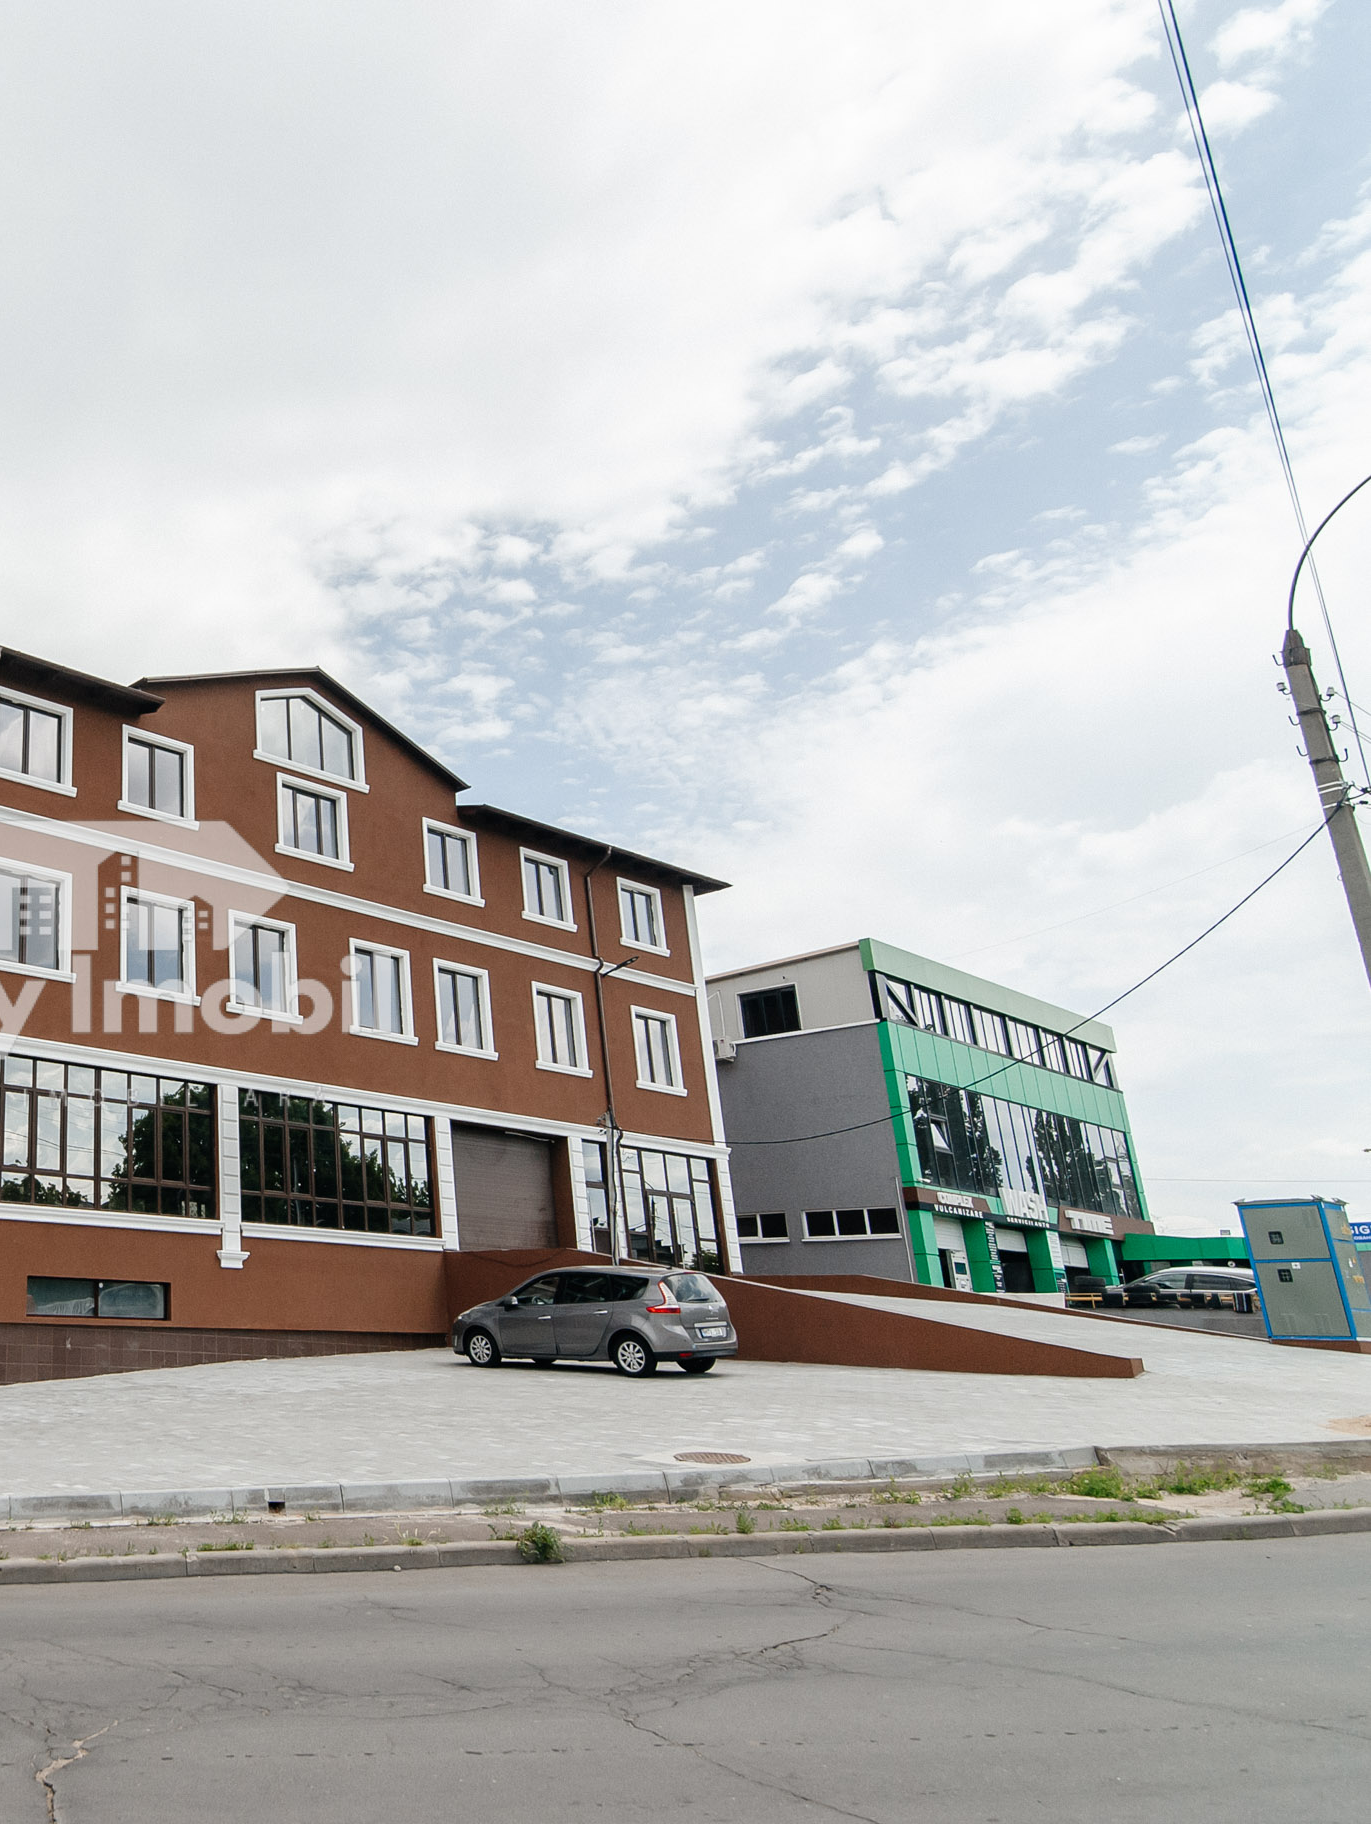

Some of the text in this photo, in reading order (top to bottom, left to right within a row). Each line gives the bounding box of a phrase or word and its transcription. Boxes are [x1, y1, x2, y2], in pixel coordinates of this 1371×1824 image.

[933, 1203, 984, 1219] VULCANIZARE
[998, 1186, 1049, 1221] WASH
[1064, 1209, 1115, 1235] TIME
